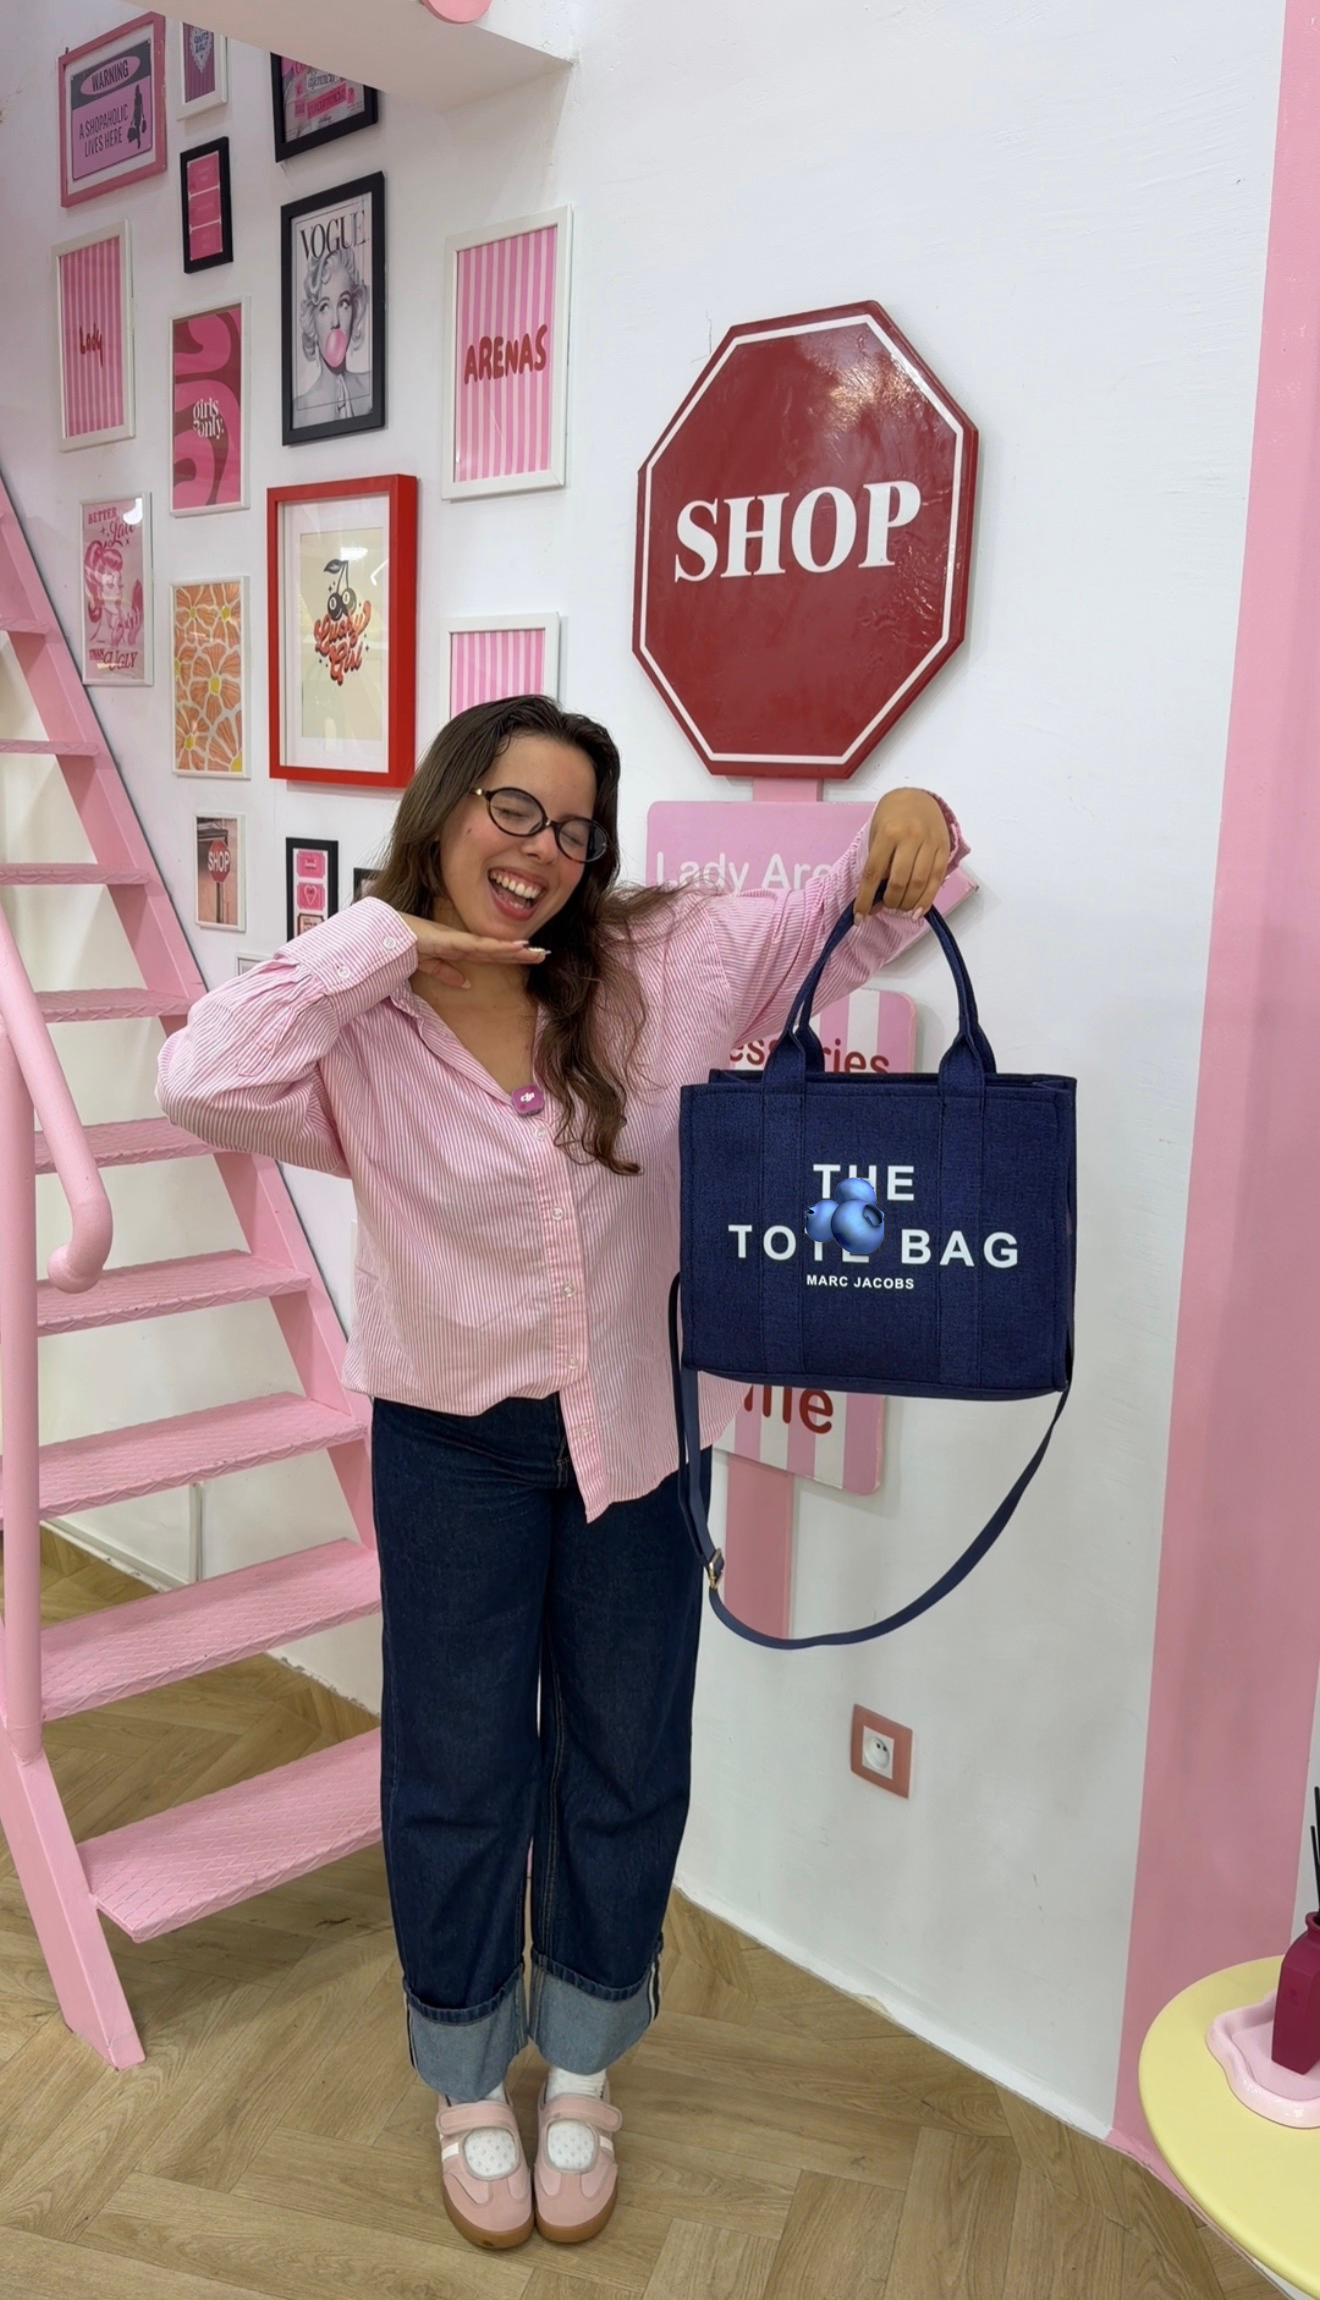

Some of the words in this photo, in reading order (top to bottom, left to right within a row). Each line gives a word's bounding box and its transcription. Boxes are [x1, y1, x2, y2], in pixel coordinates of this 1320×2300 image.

[91, 60, 129, 92] WARNING
[79, 124, 85, 140] A
[85, 104, 129, 139] SHOPAHOLIC
[84, 135, 104, 158] LIVES
[104, 126, 123, 148] HERE
[300, 209, 366, 261] VOGUE
[464, 323, 548, 385] ARENAS
[193, 398, 219, 431] girls
[88, 507, 117, 524] BETTER
[674, 480, 921, 582] SHOP
[208, 851, 231, 873] SHOP
[657, 852, 749, 897] Lady
[902, 1229, 1018, 1268] BAG
[806, 1274, 848, 1288] MARC
[853, 1276, 915, 1290] JACOBS
